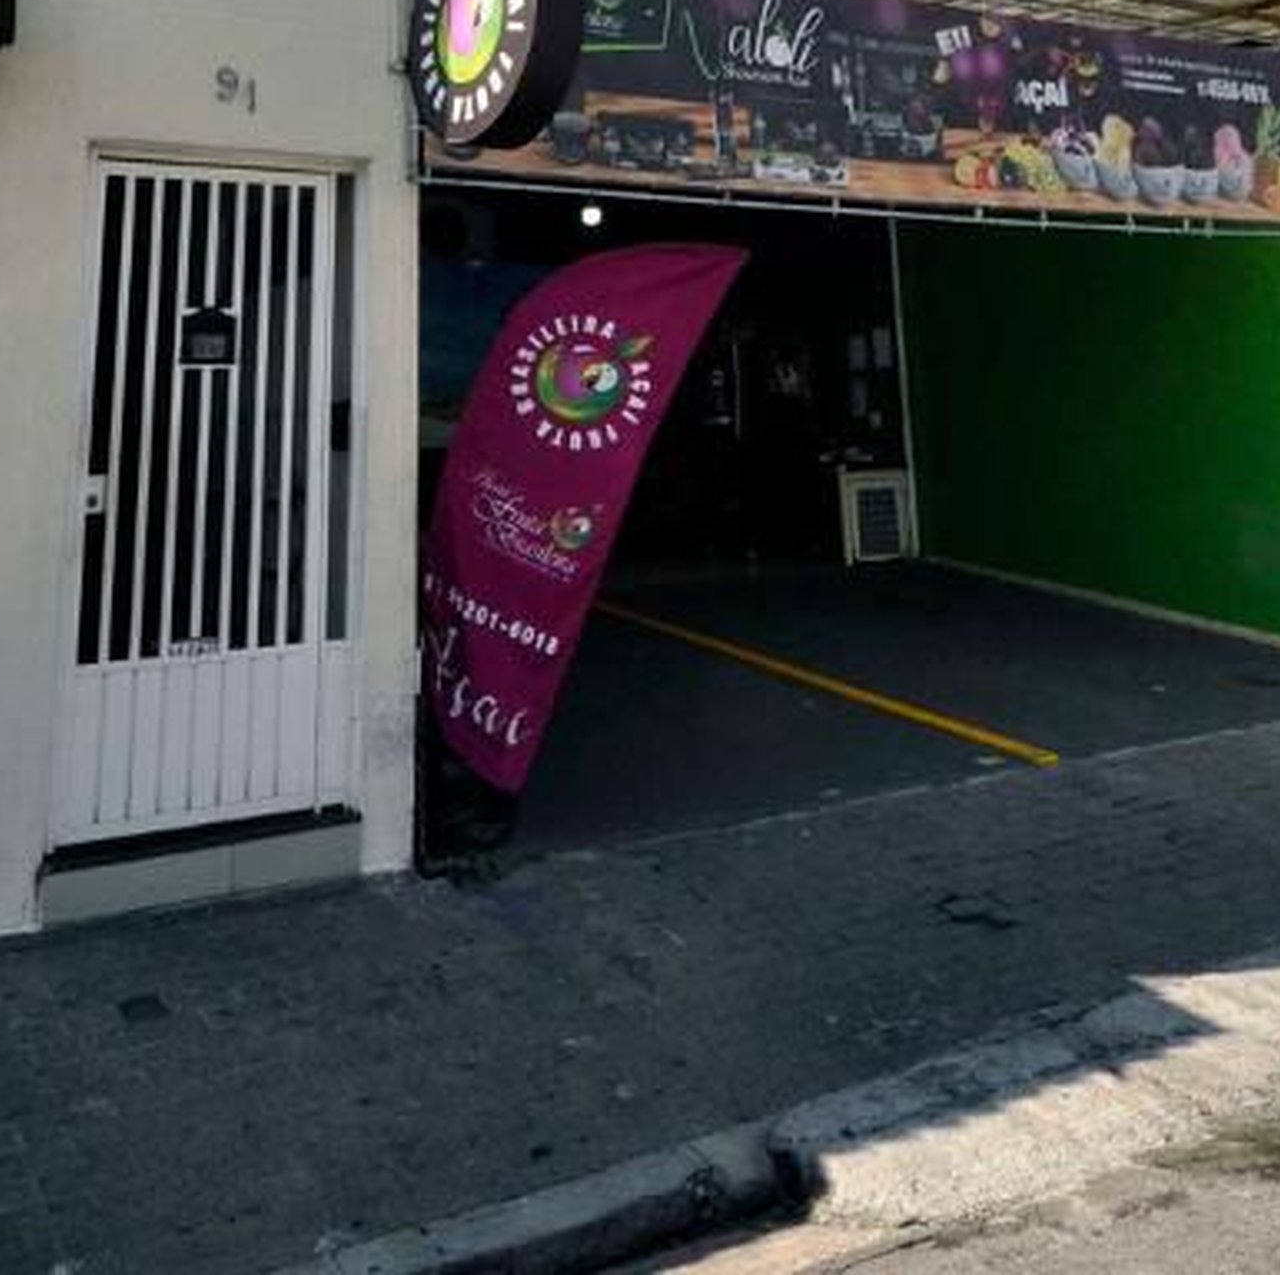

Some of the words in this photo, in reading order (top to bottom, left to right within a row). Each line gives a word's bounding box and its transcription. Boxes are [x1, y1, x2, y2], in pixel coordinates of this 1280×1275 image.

[216, 67, 257, 114] 91
[510, 315, 615, 415] BRASILEIRA
[536, 420, 618, 450] FRUTA
